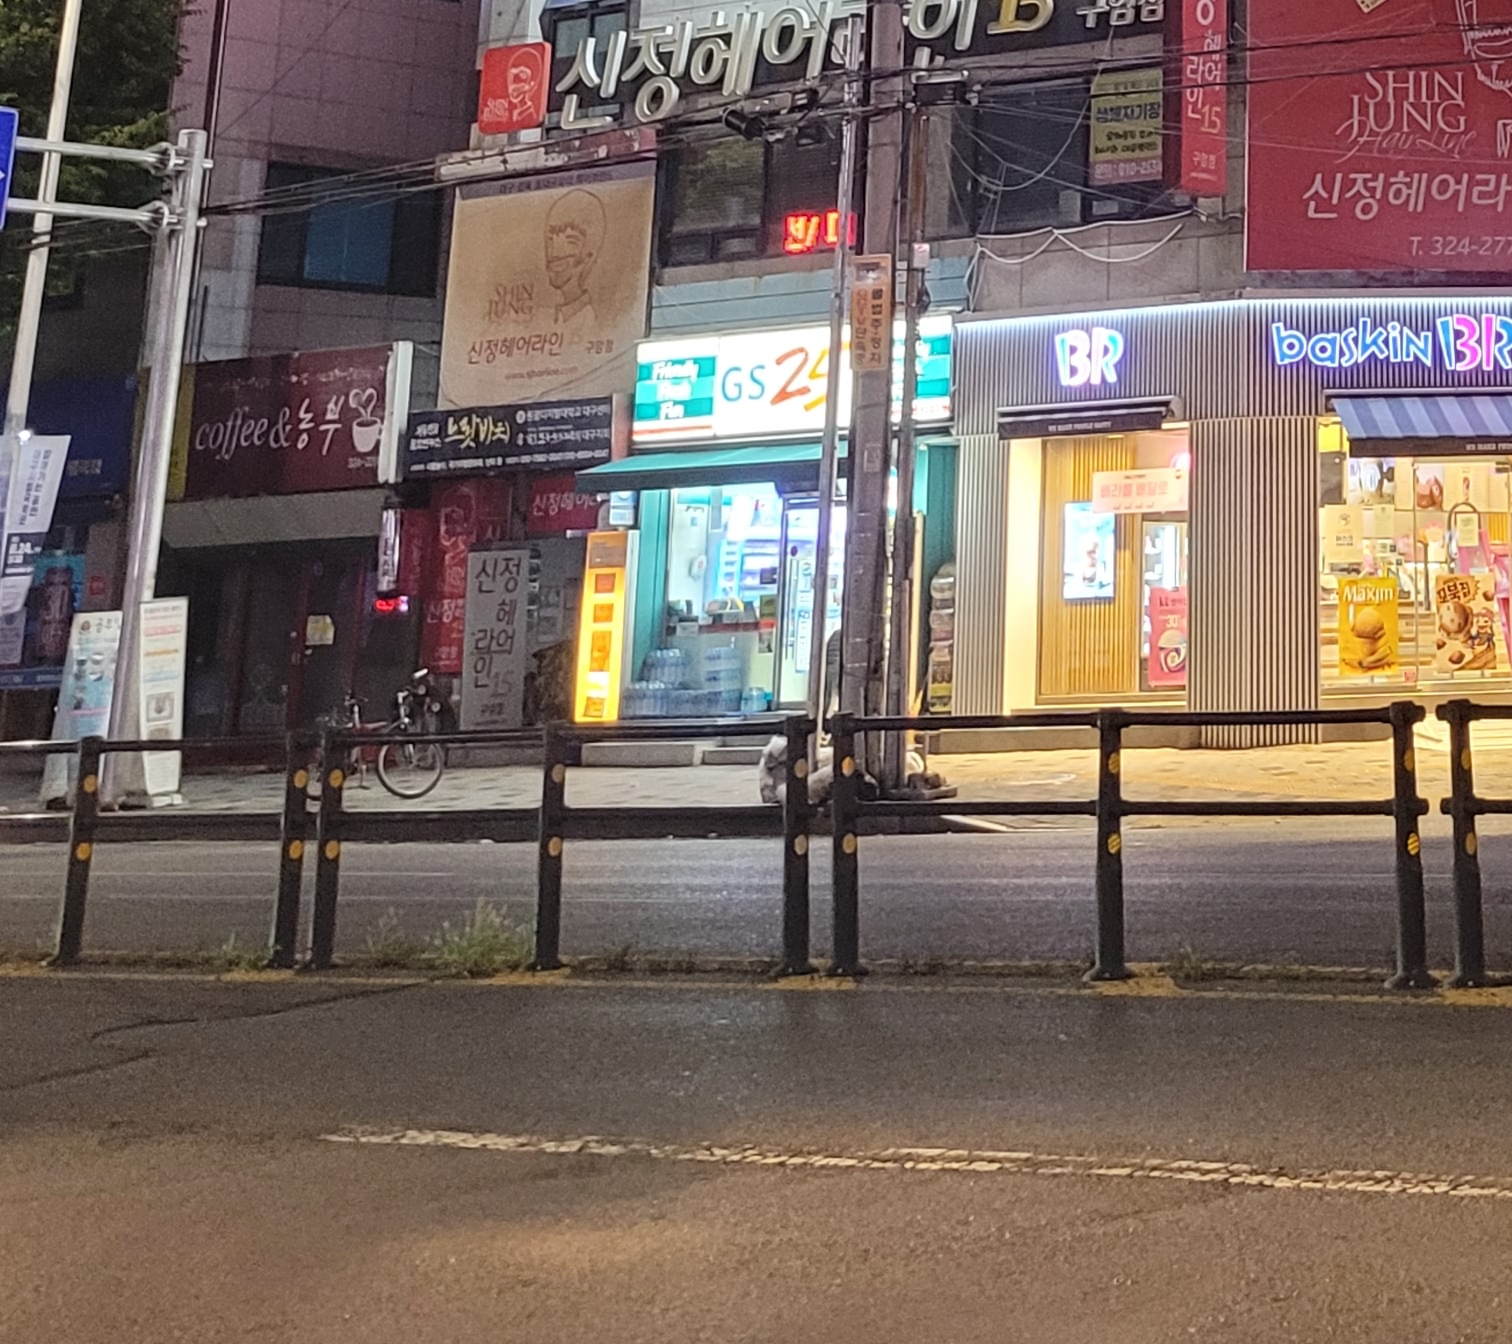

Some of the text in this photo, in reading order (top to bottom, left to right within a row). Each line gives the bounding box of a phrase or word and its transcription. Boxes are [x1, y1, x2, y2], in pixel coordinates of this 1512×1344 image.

[1363, 70, 1466, 103] SHIN
[1345, 93, 1468, 140] JUNG
[467, 331, 565, 365] 신정헤어라인
[1055, 327, 1125, 386] BR
[474, 557, 522, 595] 신정
[1342, 584, 1394, 603] Maxim
